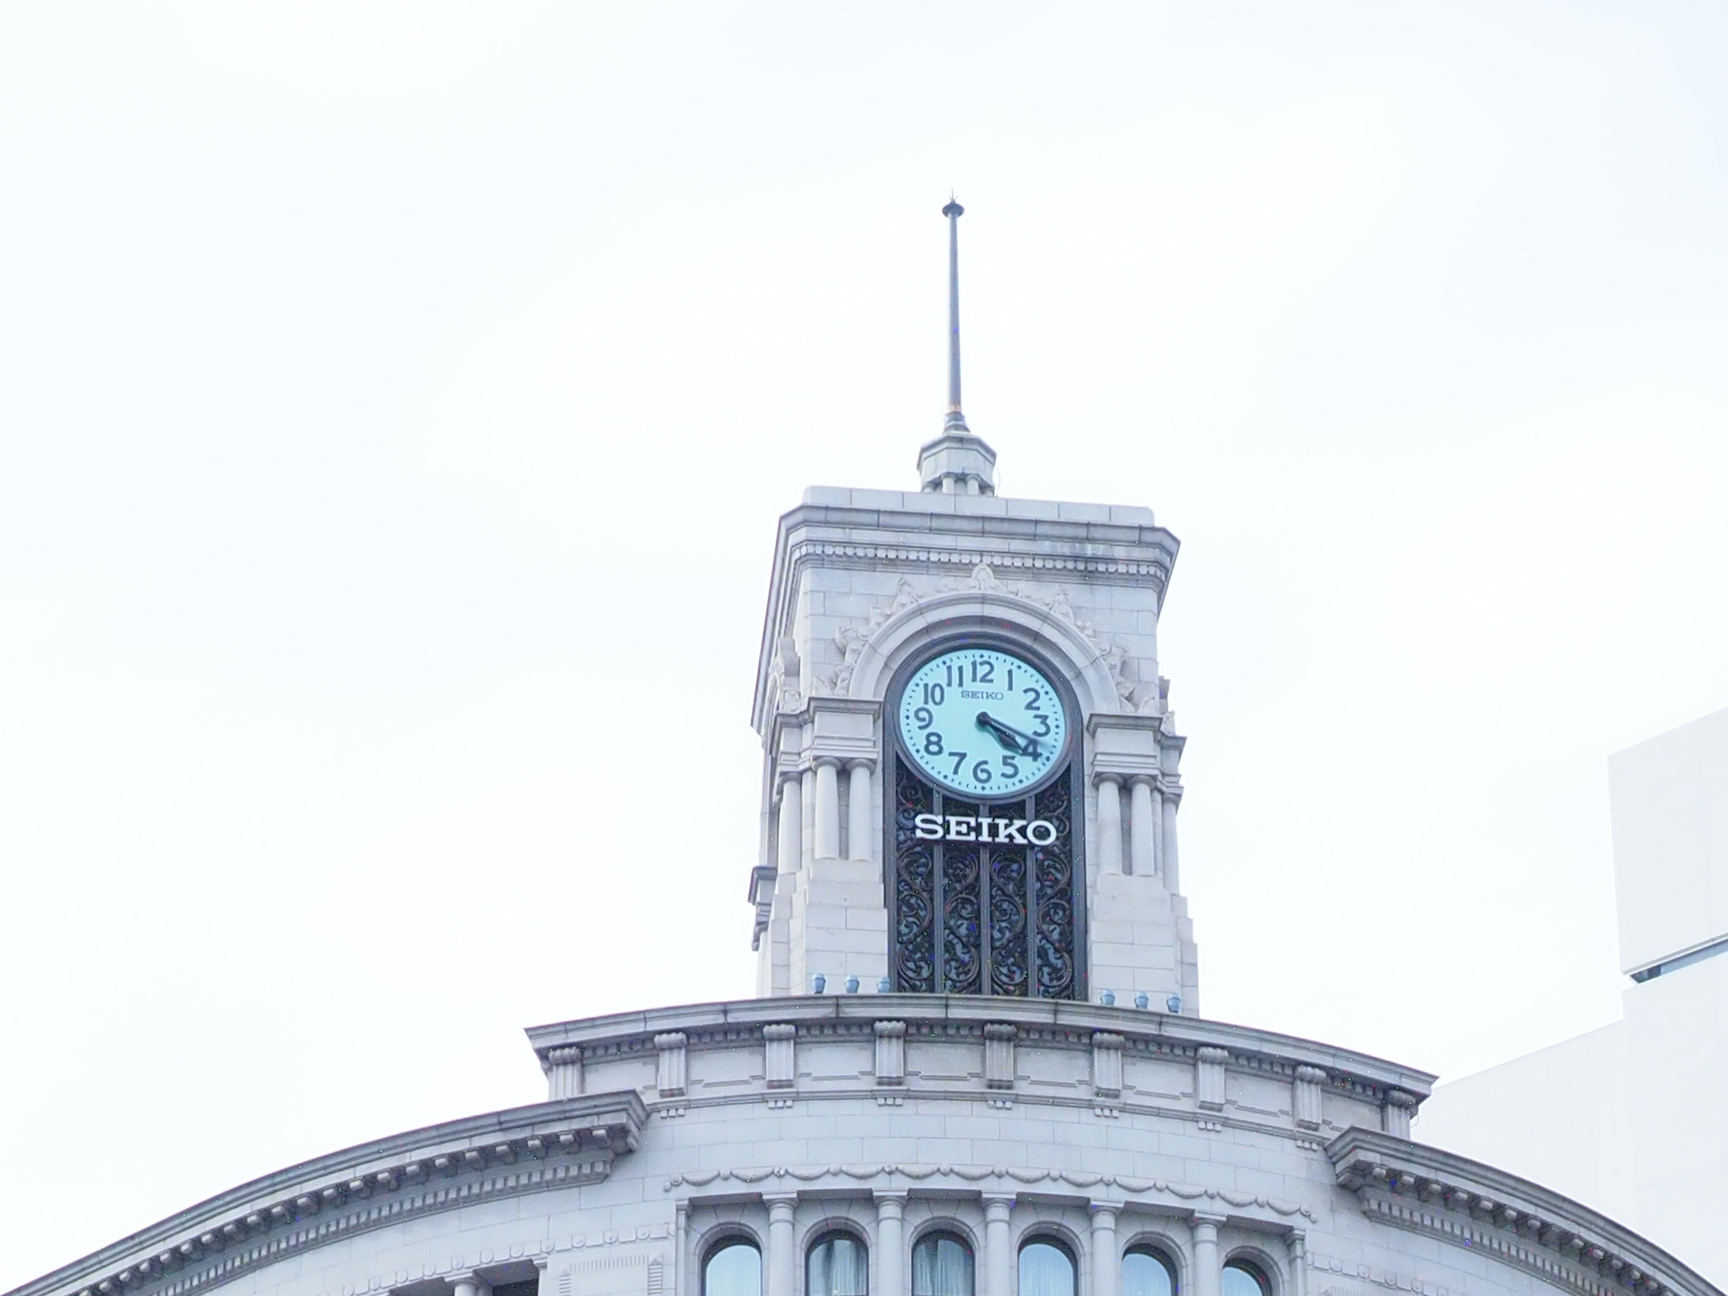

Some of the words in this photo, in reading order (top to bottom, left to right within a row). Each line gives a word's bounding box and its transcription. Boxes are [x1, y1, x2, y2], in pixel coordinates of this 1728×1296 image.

[946, 665, 964, 688] 11
[971, 659, 995, 684] 12
[923, 682, 945, 706] 10
[961, 690, 1004, 701] SEIKO
[1023, 687, 1041, 711] 2
[914, 707, 934, 730] 9
[1033, 714, 1051, 737] 3
[924, 731, 944, 755] 8
[948, 751, 967, 775] 7
[972, 760, 992, 784] 6
[1001, 755, 1020, 779] 5
[914, 813, 1057, 846] SEIKO
